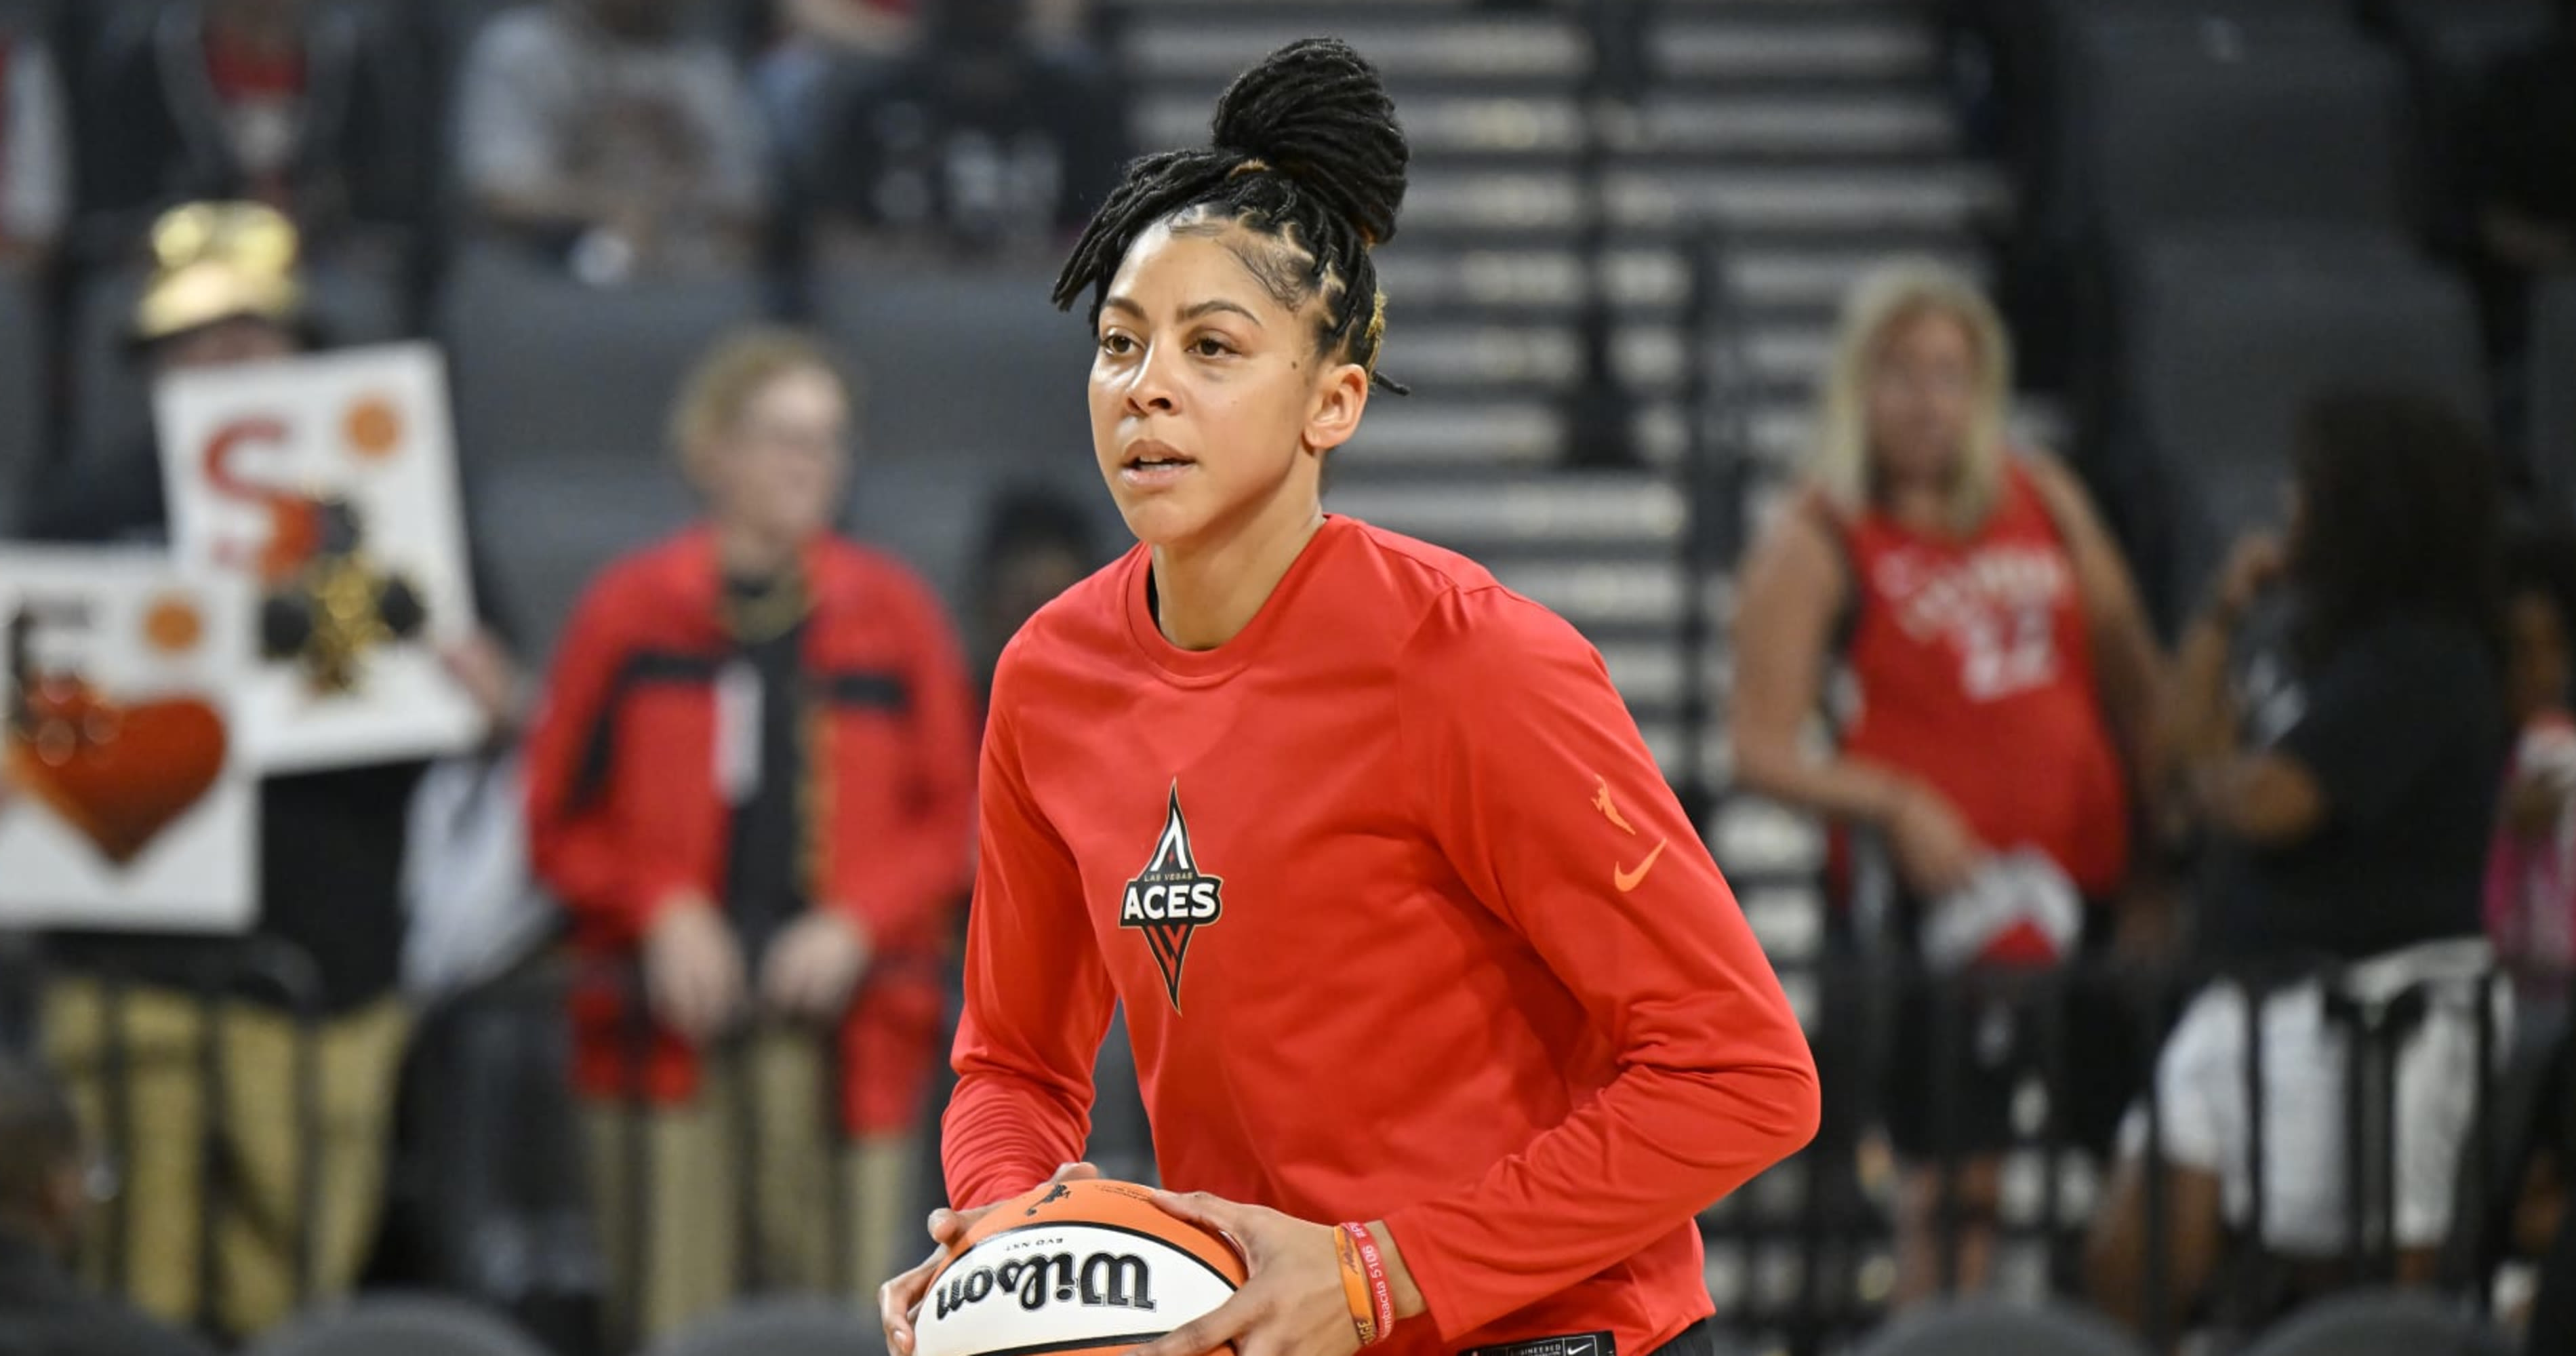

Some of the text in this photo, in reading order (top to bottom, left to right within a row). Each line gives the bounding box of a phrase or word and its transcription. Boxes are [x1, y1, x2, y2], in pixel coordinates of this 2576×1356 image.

[1144, 872, 1193, 881] LAS VEGAS
[1124, 883, 1215, 919] ACES
[936, 1252, 1156, 1321] Wilson
